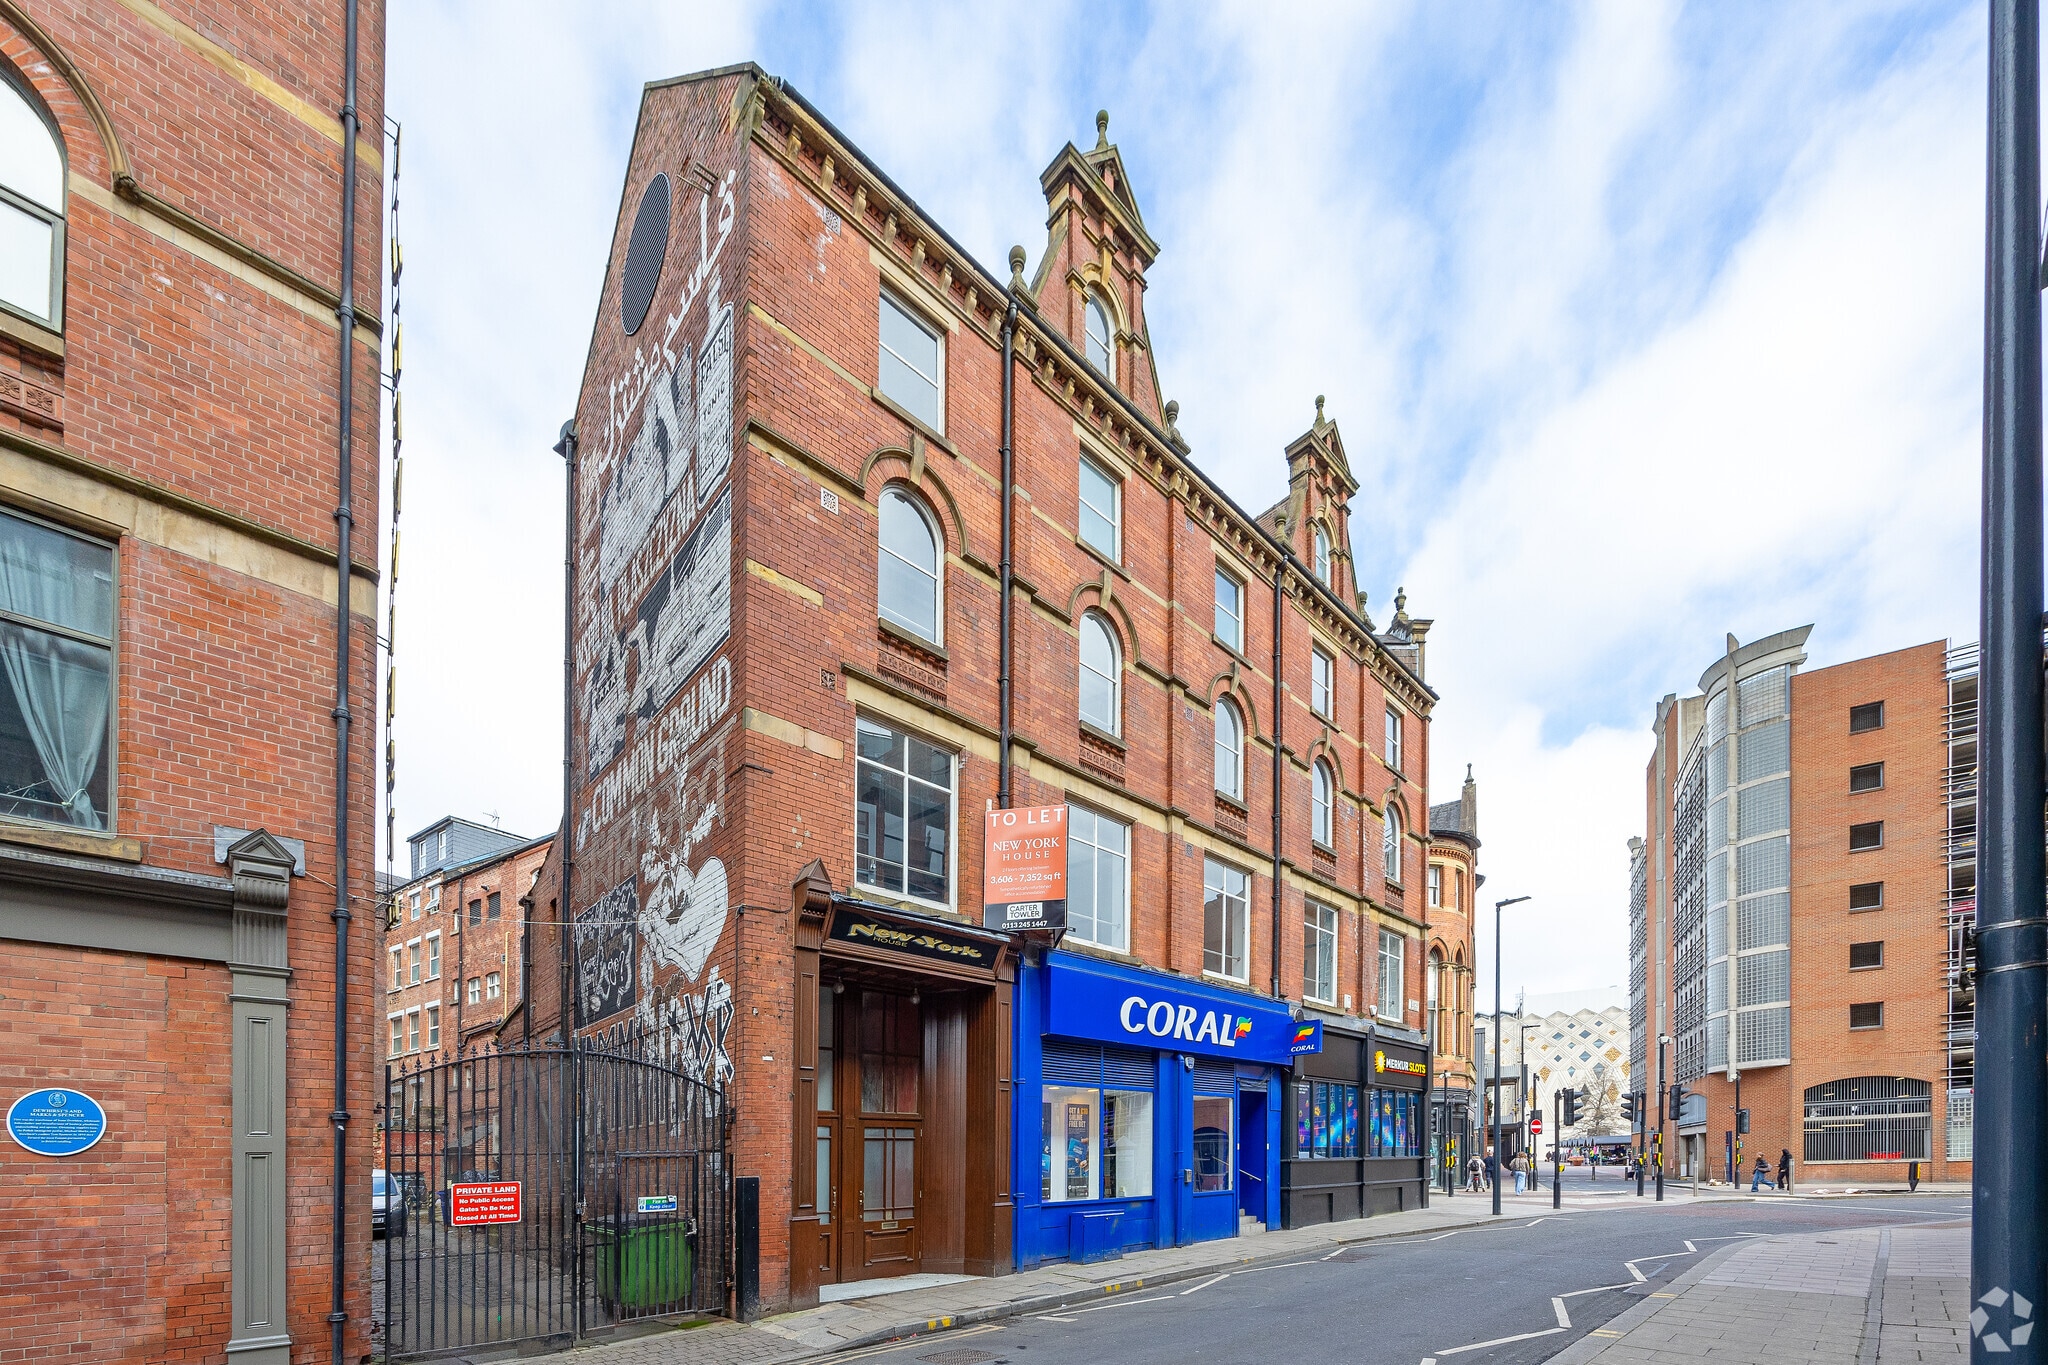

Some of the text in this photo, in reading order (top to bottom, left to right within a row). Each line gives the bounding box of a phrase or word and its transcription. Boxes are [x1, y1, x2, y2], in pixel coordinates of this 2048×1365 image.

[592, 728, 656, 834] COMMON
[656, 654, 732, 775] GROUND
[989, 807, 1064, 828] TO LET
[992, 836, 1060, 853] NEW YORK
[1002, 850, 1050, 861] HOUSE
[990, 875, 1013, 885] 3,606
[1019, 873, 1042, 882] 7,352
[1054, 872, 1061, 880] ft
[1009, 904, 1038, 912] CARTER
[847, 923, 982, 958] New York
[873, 936, 907, 948] HOUSE
[1120, 996, 1237, 1047] CORAL
[1290, 1044, 1316, 1053] CORAL
[1409, 1062, 1426, 1074] SLOTS
